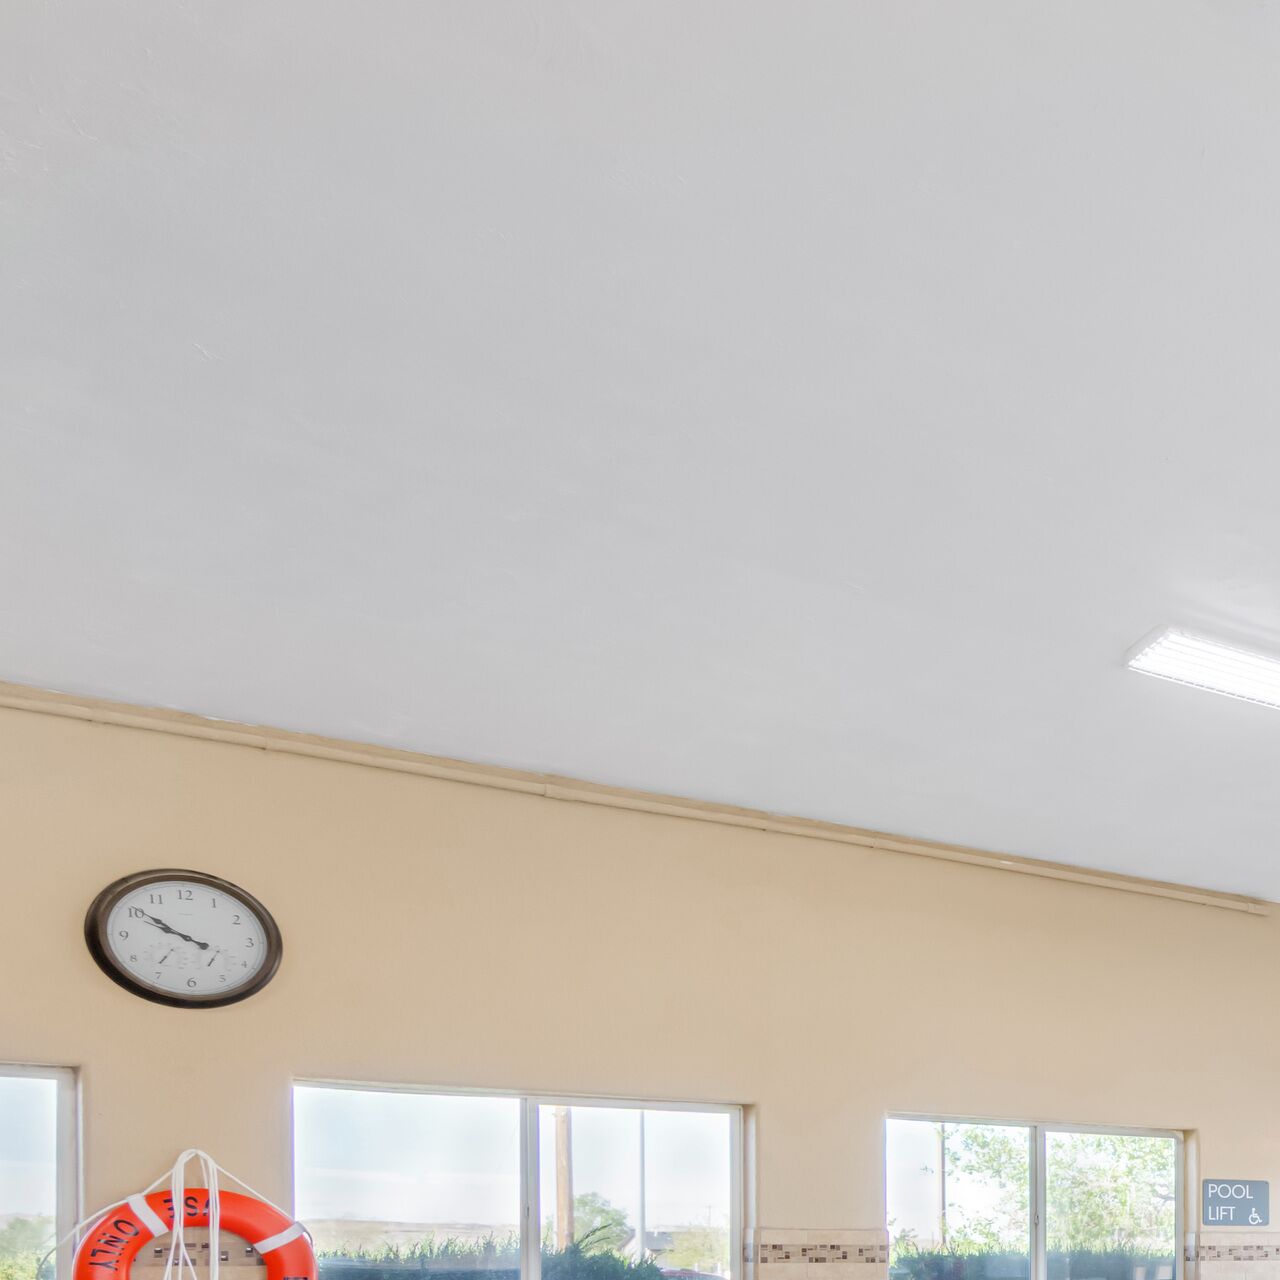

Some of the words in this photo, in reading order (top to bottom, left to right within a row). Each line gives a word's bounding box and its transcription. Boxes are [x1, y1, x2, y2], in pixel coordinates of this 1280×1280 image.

[150, 893, 164, 905] 11
[177, 889, 194, 901] 12
[211, 898, 217, 908] 1
[128, 907, 145, 918] 10
[232, 914, 241, 925] 2
[119, 930, 129, 940] 9
[245, 937, 255, 948] 3
[130, 954, 138, 963] 8
[154, 971, 162, 980] 7
[219, 974, 227, 983] 5
[187, 977, 197, 988] 6
[1208, 1183, 1254, 1199] POOL
[1208, 1206, 1236, 1221] LIFT
[89, 1219, 140, 1272] ONLY
